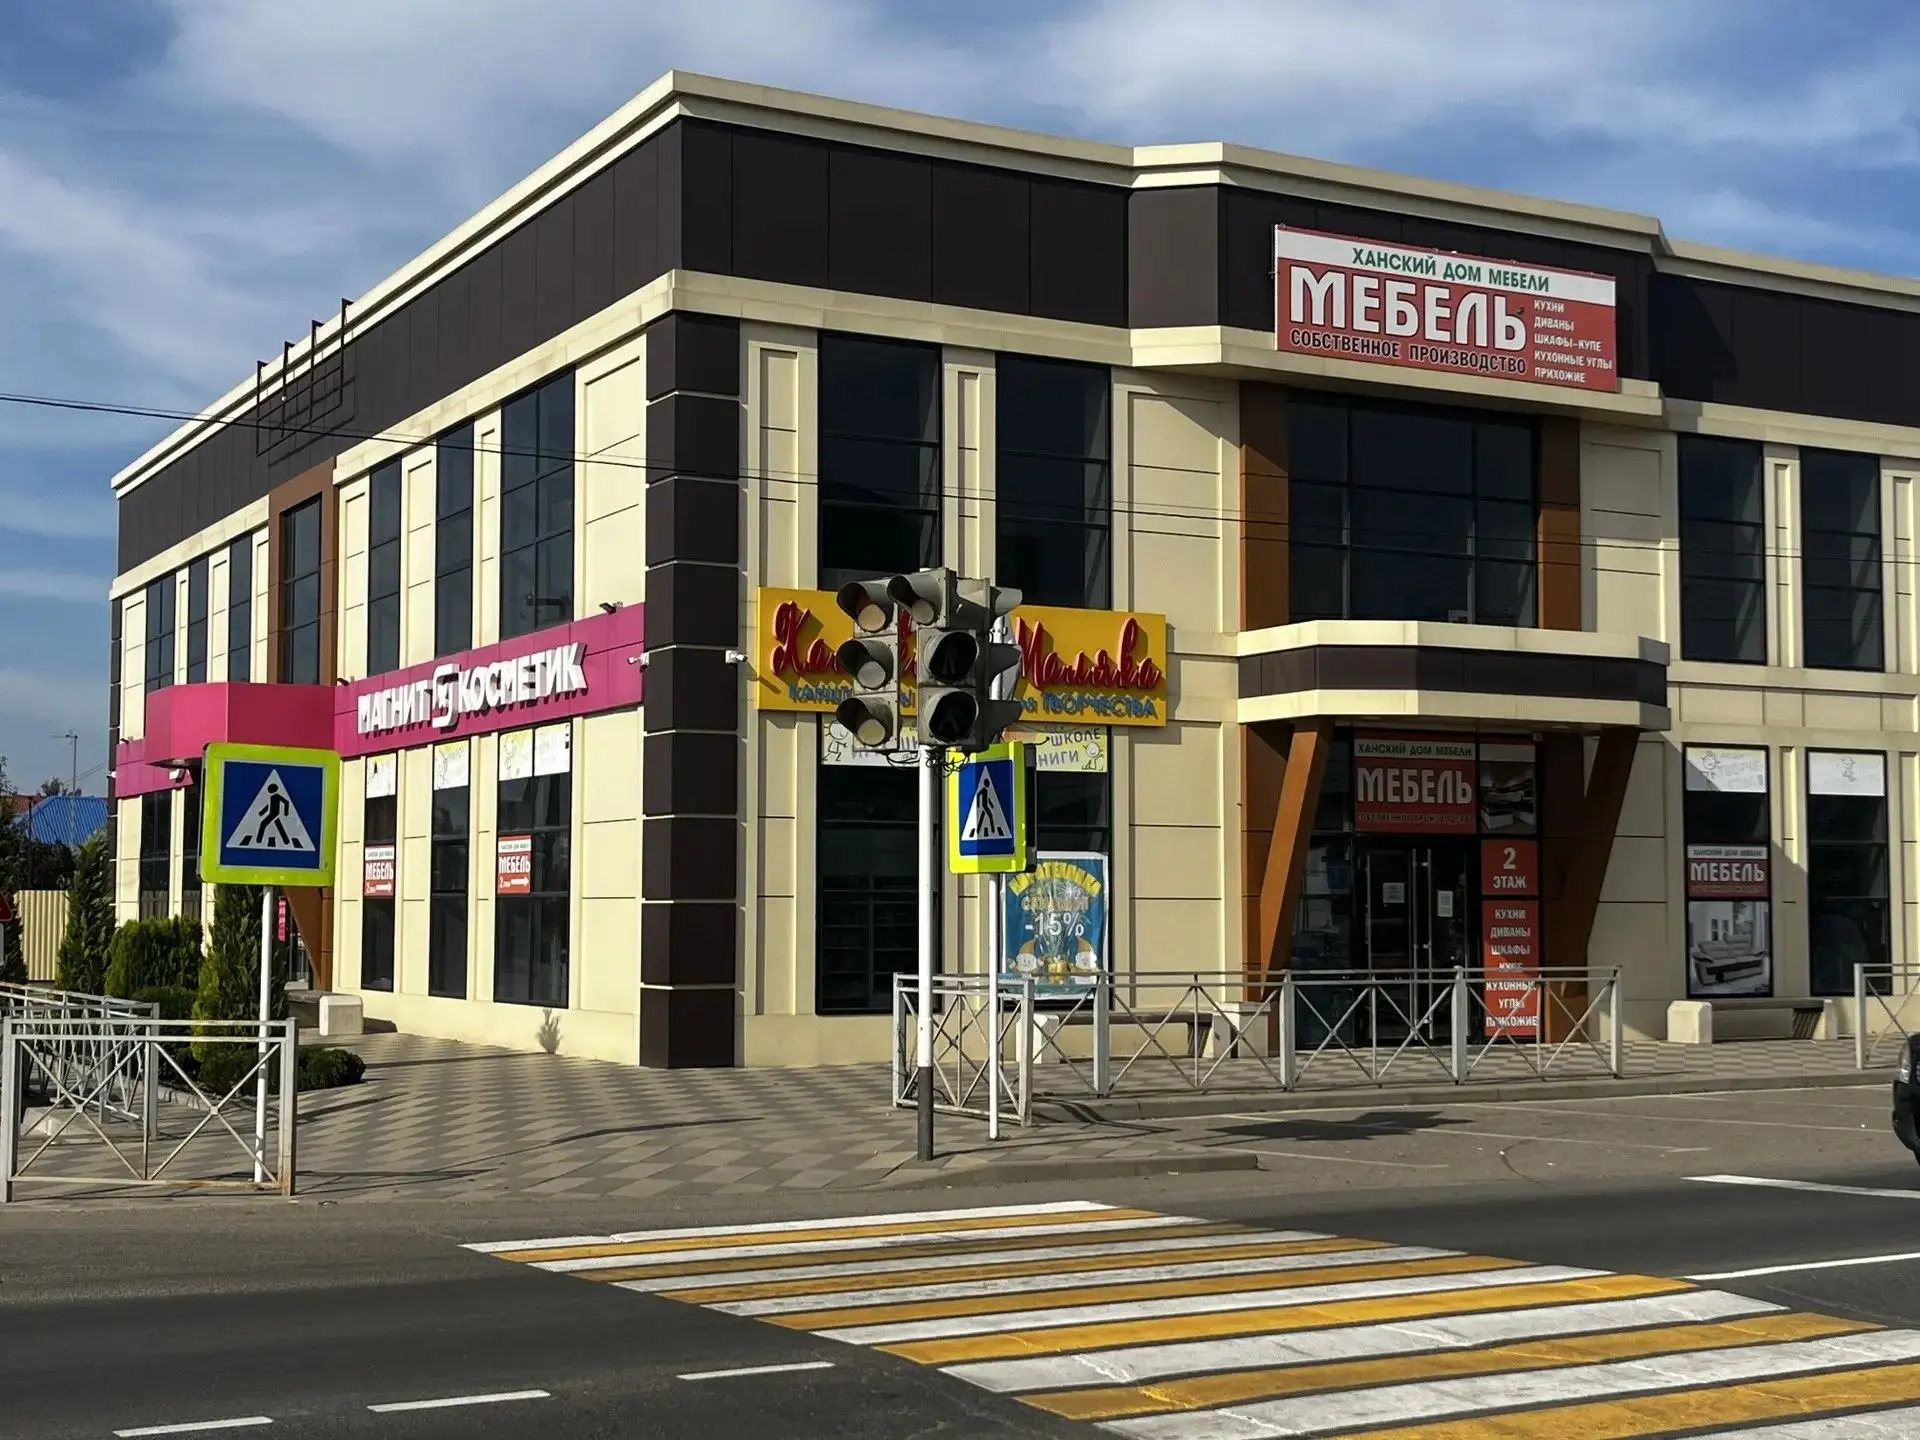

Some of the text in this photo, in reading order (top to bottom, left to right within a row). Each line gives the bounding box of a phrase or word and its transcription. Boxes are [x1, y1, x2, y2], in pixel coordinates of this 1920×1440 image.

[1352, 247, 1549, 292] ХАНСКИЙ ДОМ МЕБЕЛИ
[1290, 265, 1527, 352] МЕБЕЛЬ
[1534, 299, 1564, 313] КУХНИ
[1534, 316, 1574, 331] ДИВАНЫ
[1291, 329, 1526, 375] СОБСТВЕННОЕ ПРОИЗВОДСТВО
[1534, 333, 1602, 352] ШКАФЫ-КУПЕ
[1534, 350, 1612, 370] КУХОННЫЕ УГЛЫ
[1534, 367, 1586, 383] ПРИХОЖИЕ
[358, 642, 587, 734] МАГНИТ КОСМЕТИК
[1042, 691, 1158, 719] ТВОРЧЕСТВА
[1051, 727, 1101, 746] ШКОЛЕ
[1038, 750, 1079, 768] НИГИ
[1359, 742, 1472, 757] ХАНСКИЙ ДОМ МЕБЕЛИ
[1357, 767, 1473, 804] МЕБЕЛЬ
[499, 855, 531, 873] МЕБЕЛЬ
[1503, 847, 1516, 870] 2
[366, 862, 394, 880] МЕБЕЛЬ
[1690, 862, 1765, 881] МЕБЕЛЬ
[1492, 875, 1527, 889] ЭТАЖ
[1025, 912, 1085, 936] -15%
[1495, 909, 1526, 920] КУХНИ
[1490, 927, 1531, 939] ДИВАНЫ
[1491, 944, 1531, 955] ШКАФЫ
